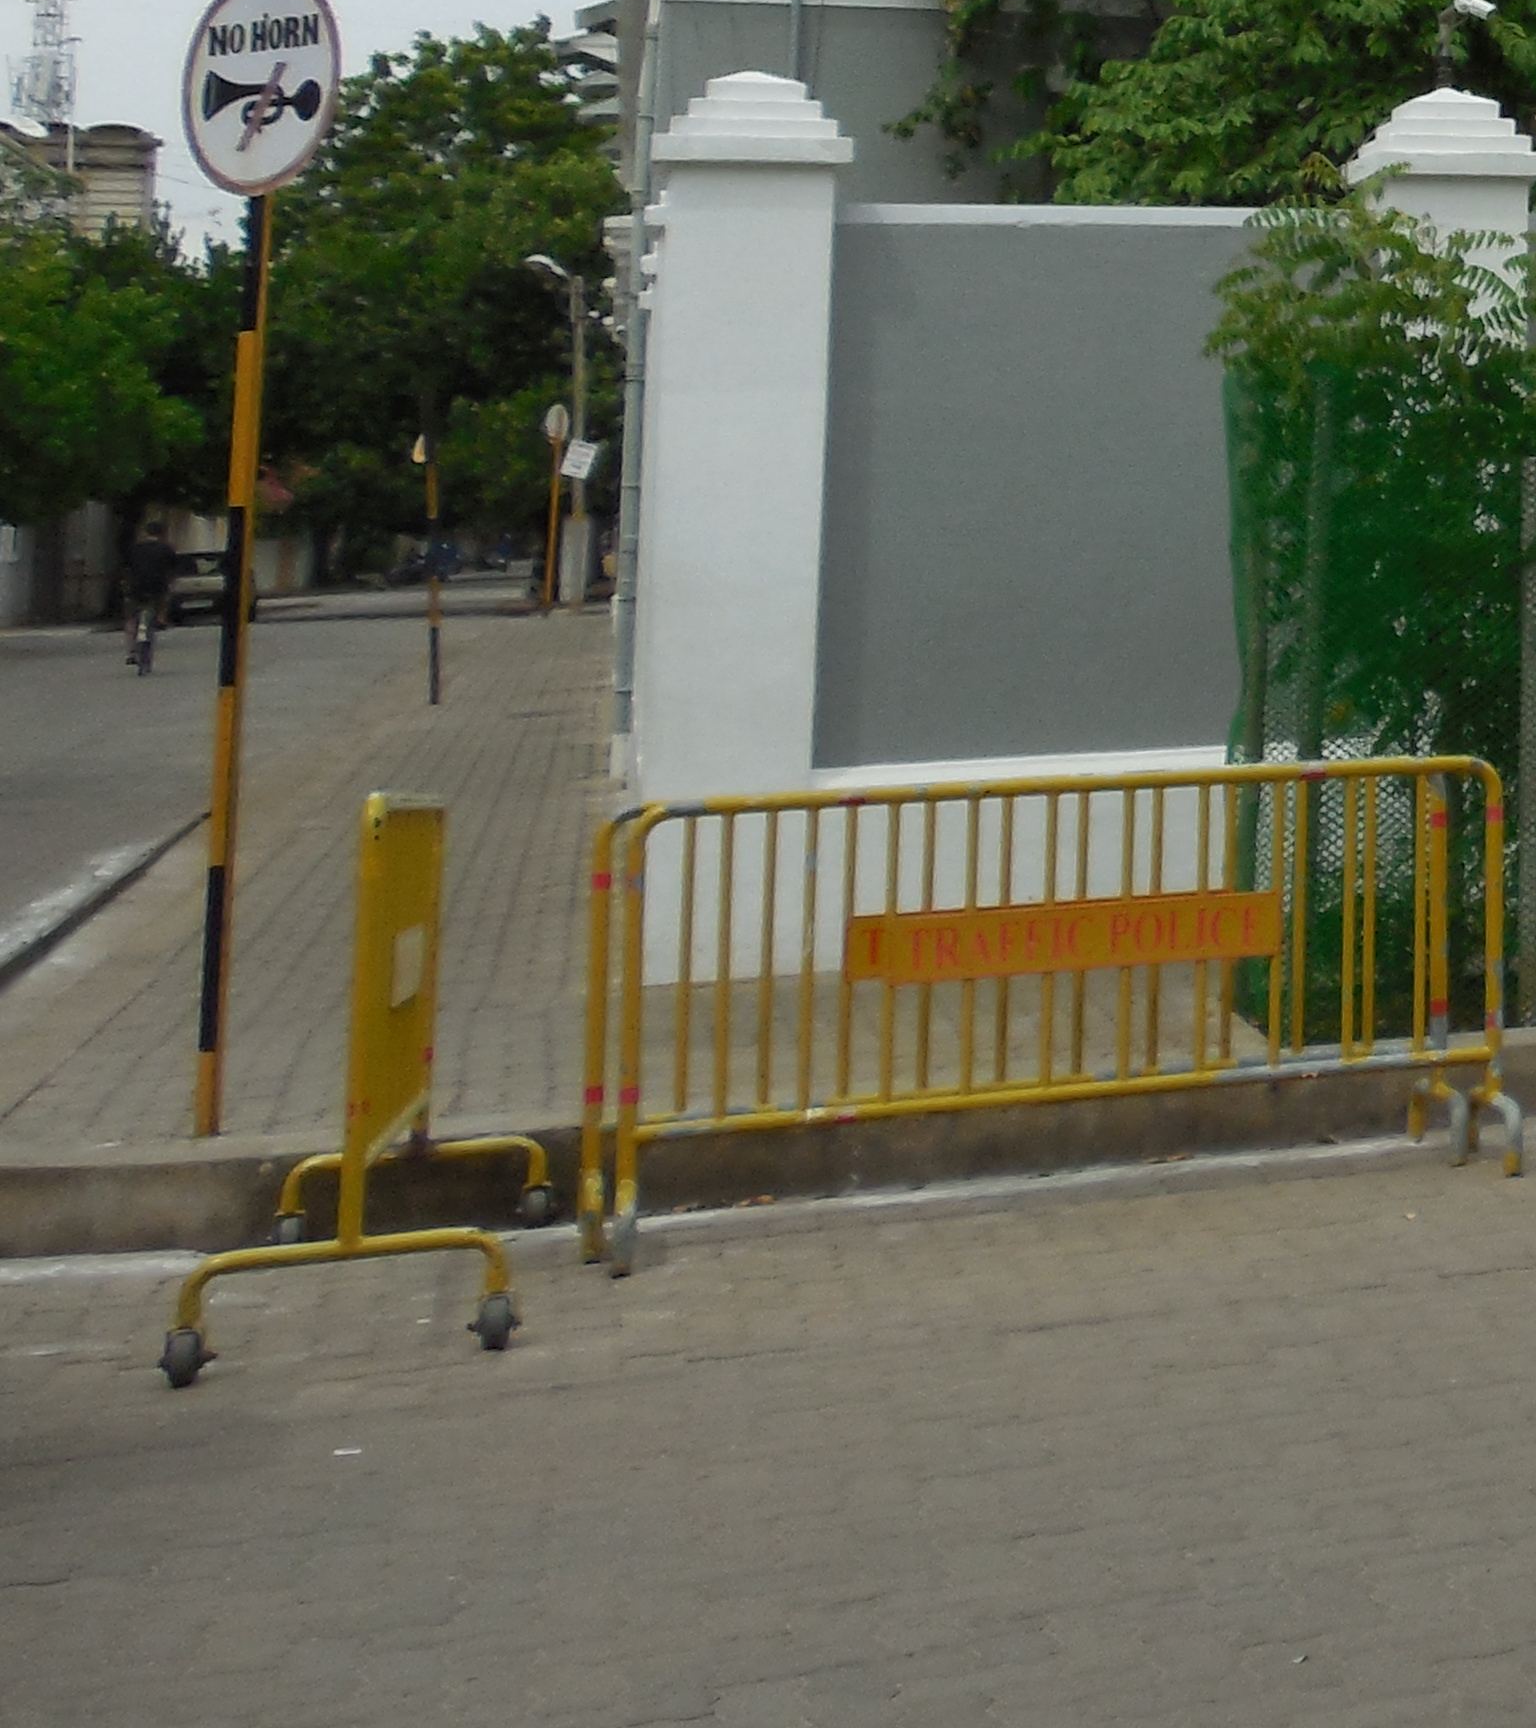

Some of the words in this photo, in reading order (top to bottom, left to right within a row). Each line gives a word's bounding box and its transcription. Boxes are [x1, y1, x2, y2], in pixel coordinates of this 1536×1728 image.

[208, 23, 246, 57] NO
[250, 13, 320, 53] HORN
[908, 915, 1094, 971] TRAFFIC
[1108, 905, 1263, 954] POLICE
